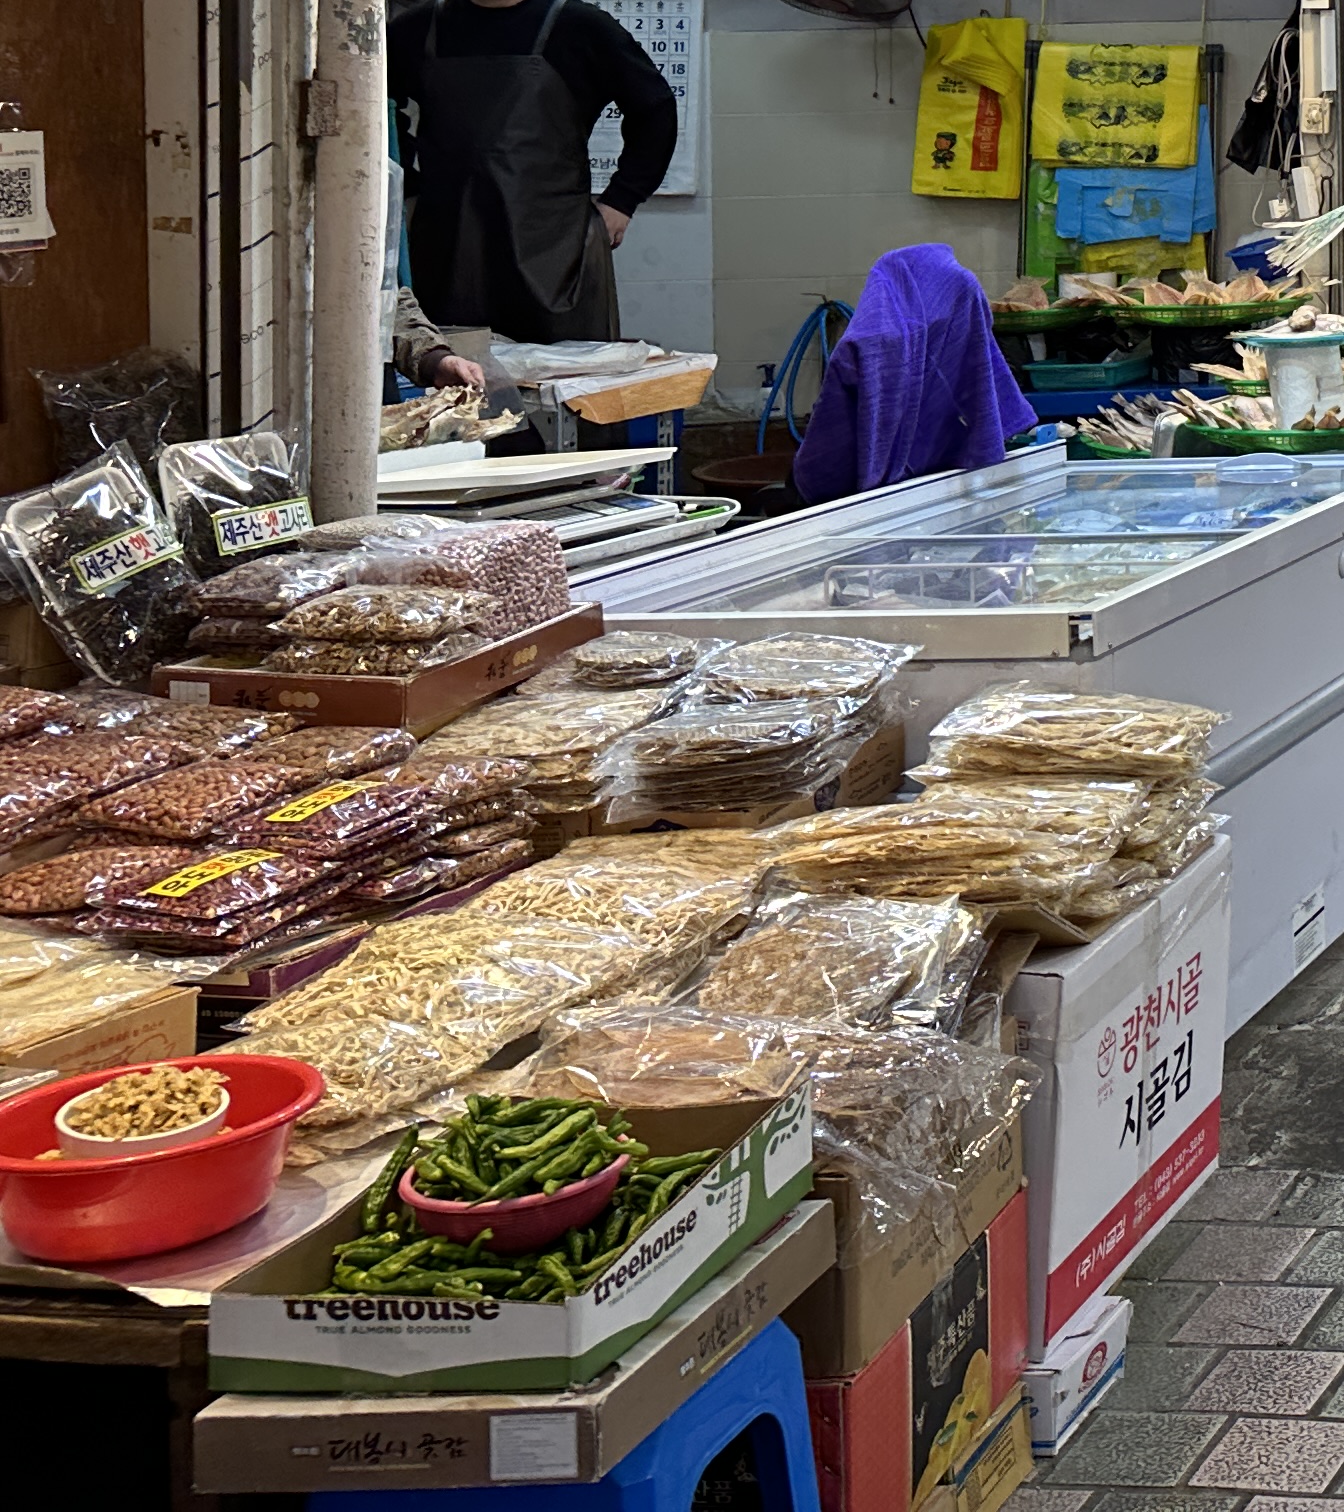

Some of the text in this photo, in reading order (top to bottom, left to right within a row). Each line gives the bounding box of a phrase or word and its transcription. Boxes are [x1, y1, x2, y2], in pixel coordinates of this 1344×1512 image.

[634, 18, 684, 30] 2 3 4
[651, 41, 685, 53] 10 11
[671, 64, 685, 75] 18
[605, 107, 622, 119] 29
[219, 515, 263, 545] 제주산
[79, 540, 137, 581] 제주산
[1120, 951, 1204, 1075] 광천시골
[1119, 1028, 1194, 1149] 시골김
[592, 1206, 698, 1307] treehouse
[1075, 1213, 1128, 1288] (주)시골김
[284, 1298, 501, 1323] treehouse
[315, 1324, 473, 1336] TRUE ALMOND GOODNESS
